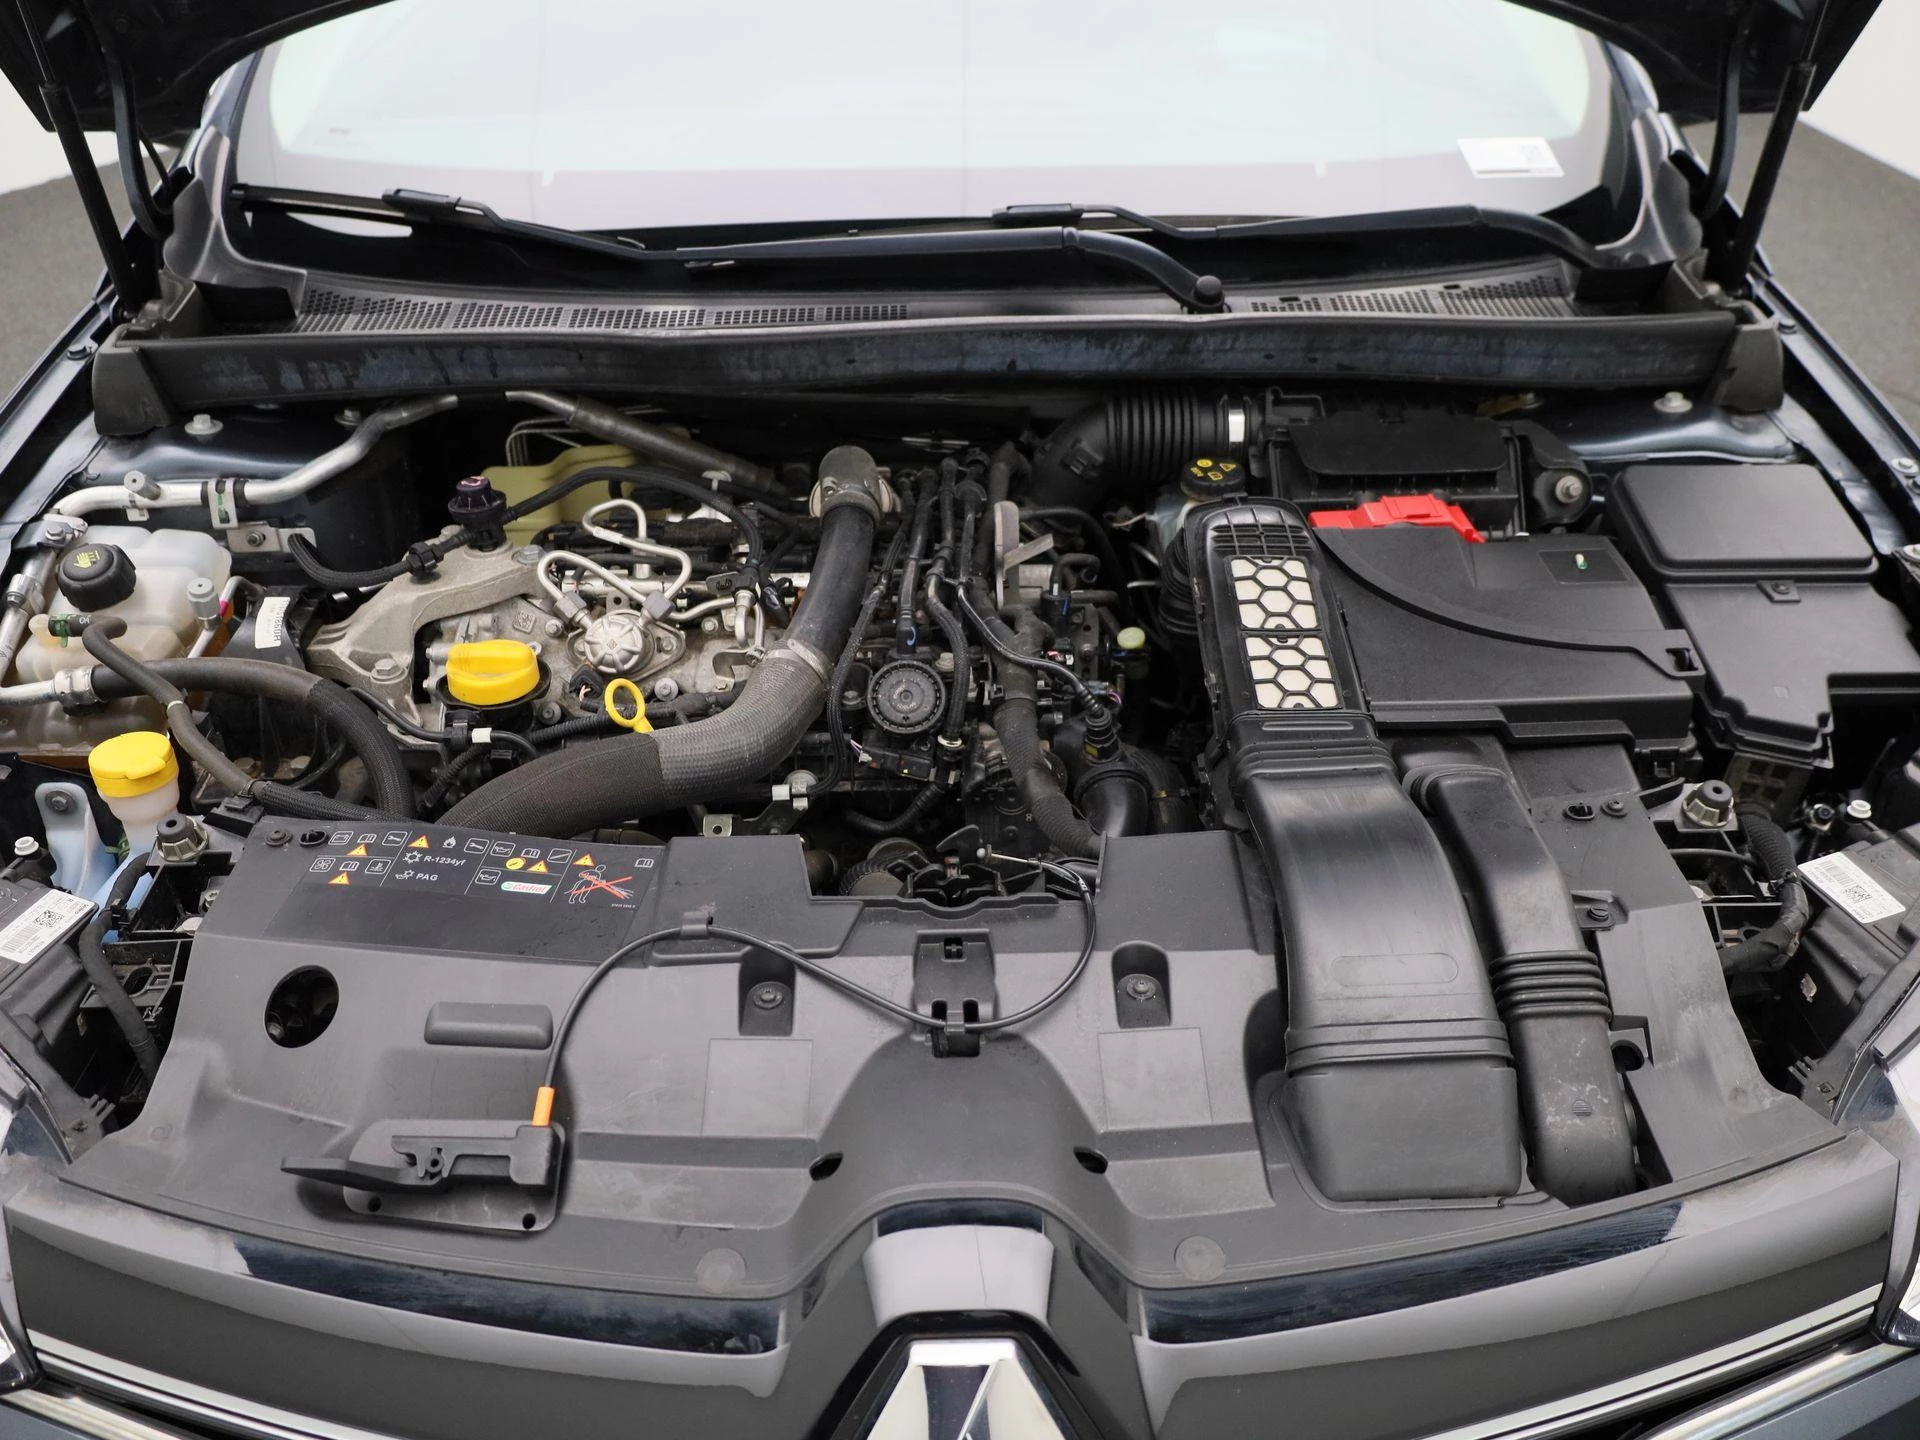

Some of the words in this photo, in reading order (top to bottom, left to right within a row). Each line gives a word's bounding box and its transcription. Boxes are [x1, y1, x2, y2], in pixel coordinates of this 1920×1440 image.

[424, 855, 466, 866] R-1234yf
[416, 873, 439, 881] PAG
[512, 883, 547, 894] Castrol
